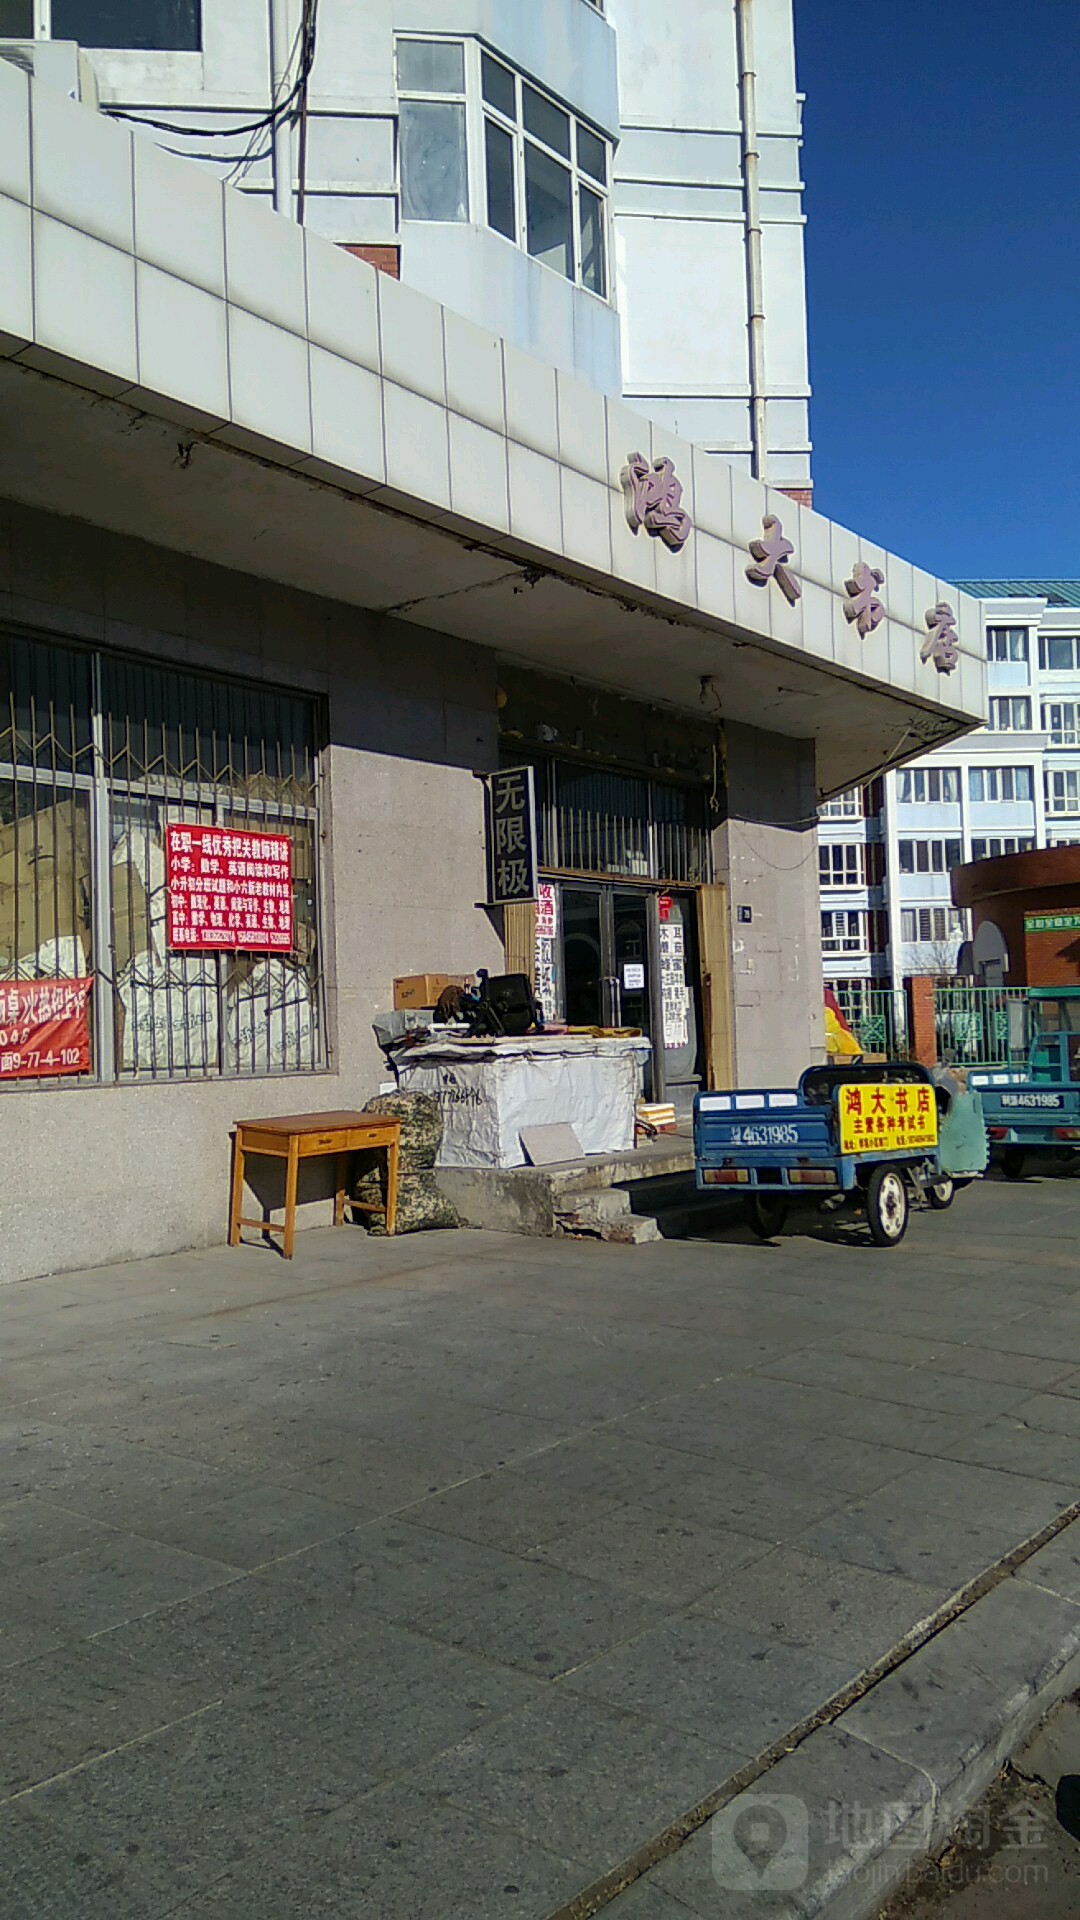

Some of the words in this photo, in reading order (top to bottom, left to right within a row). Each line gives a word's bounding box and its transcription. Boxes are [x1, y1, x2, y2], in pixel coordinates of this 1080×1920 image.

[495, 774, 530, 897] 无限极
[845, 1087, 930, 1116] 鸿大书店
